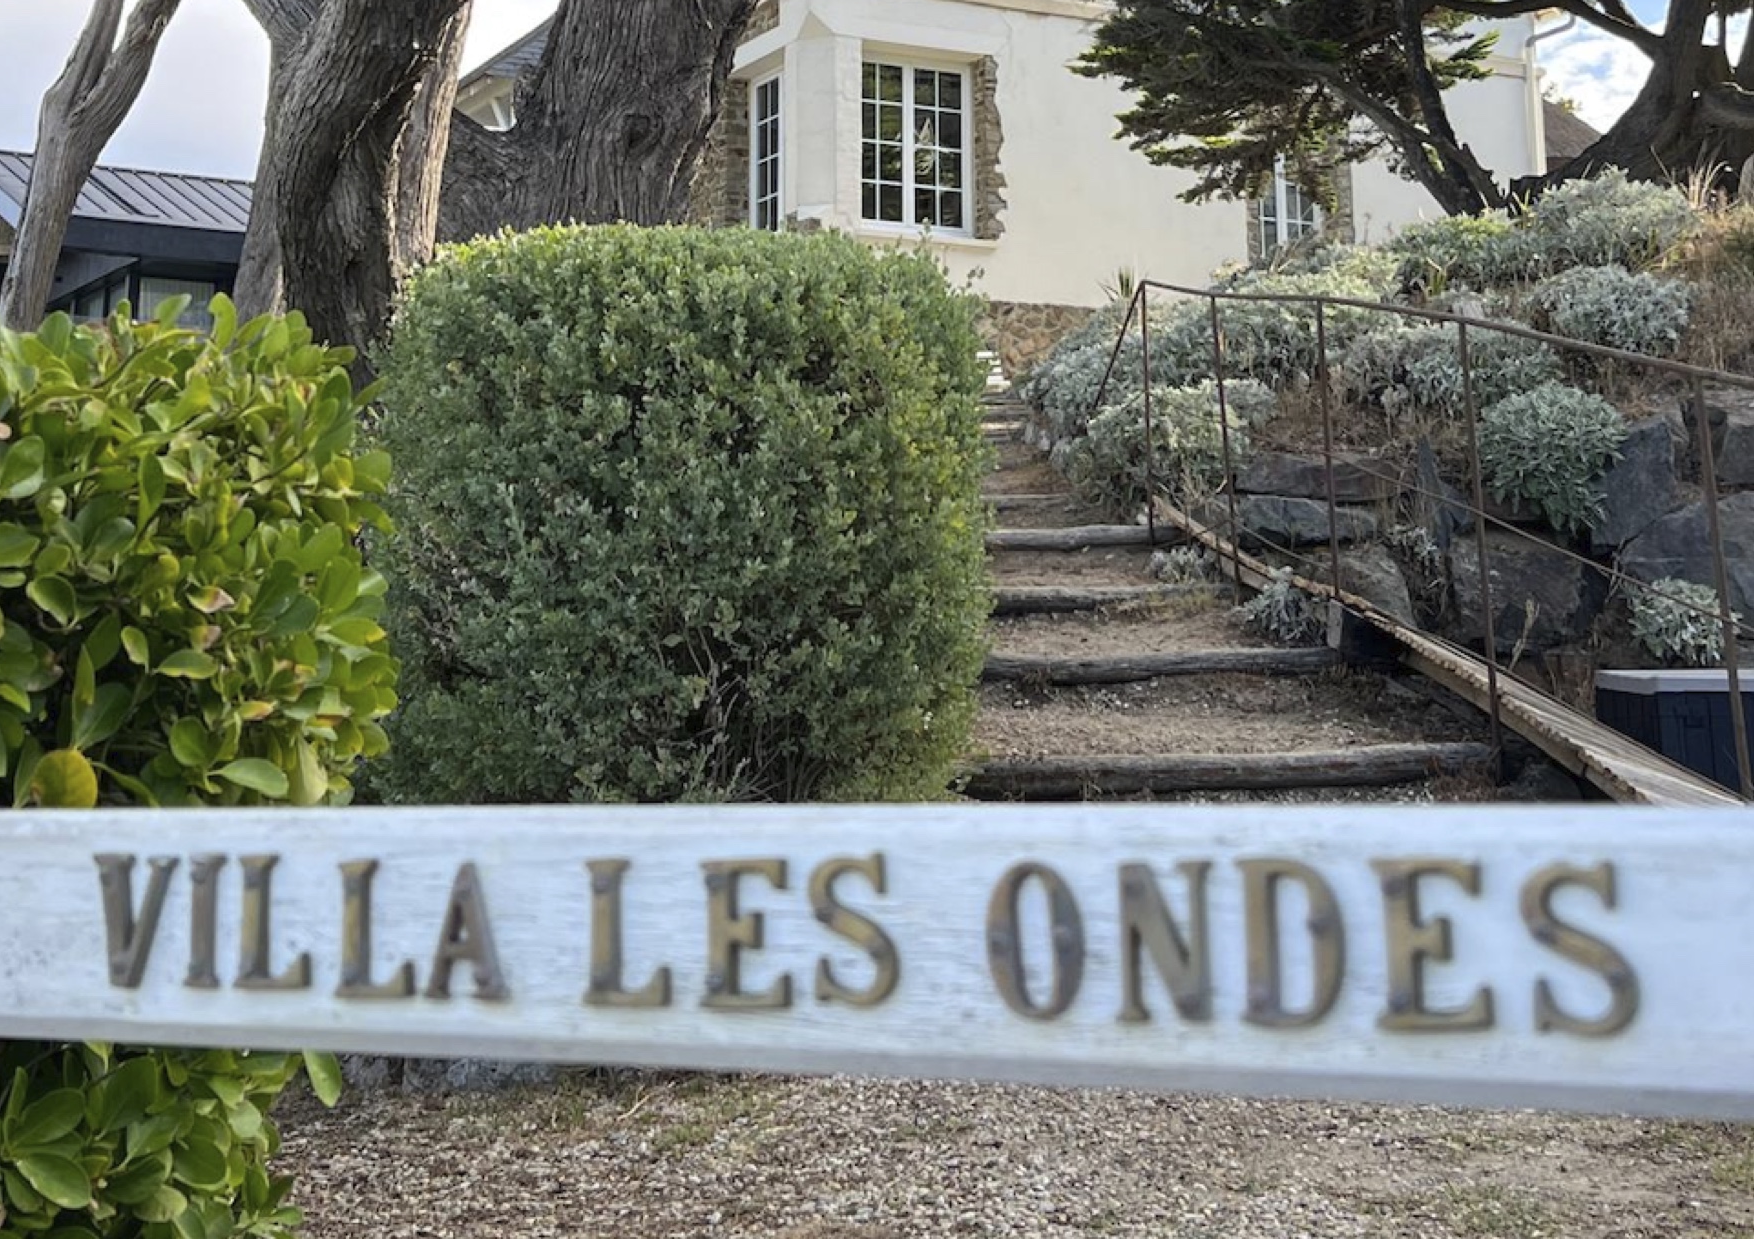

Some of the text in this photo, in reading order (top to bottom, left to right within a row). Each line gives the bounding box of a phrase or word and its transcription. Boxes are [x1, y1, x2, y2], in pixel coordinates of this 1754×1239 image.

[93, 851, 1642, 1038] VILLA LES ONDES
